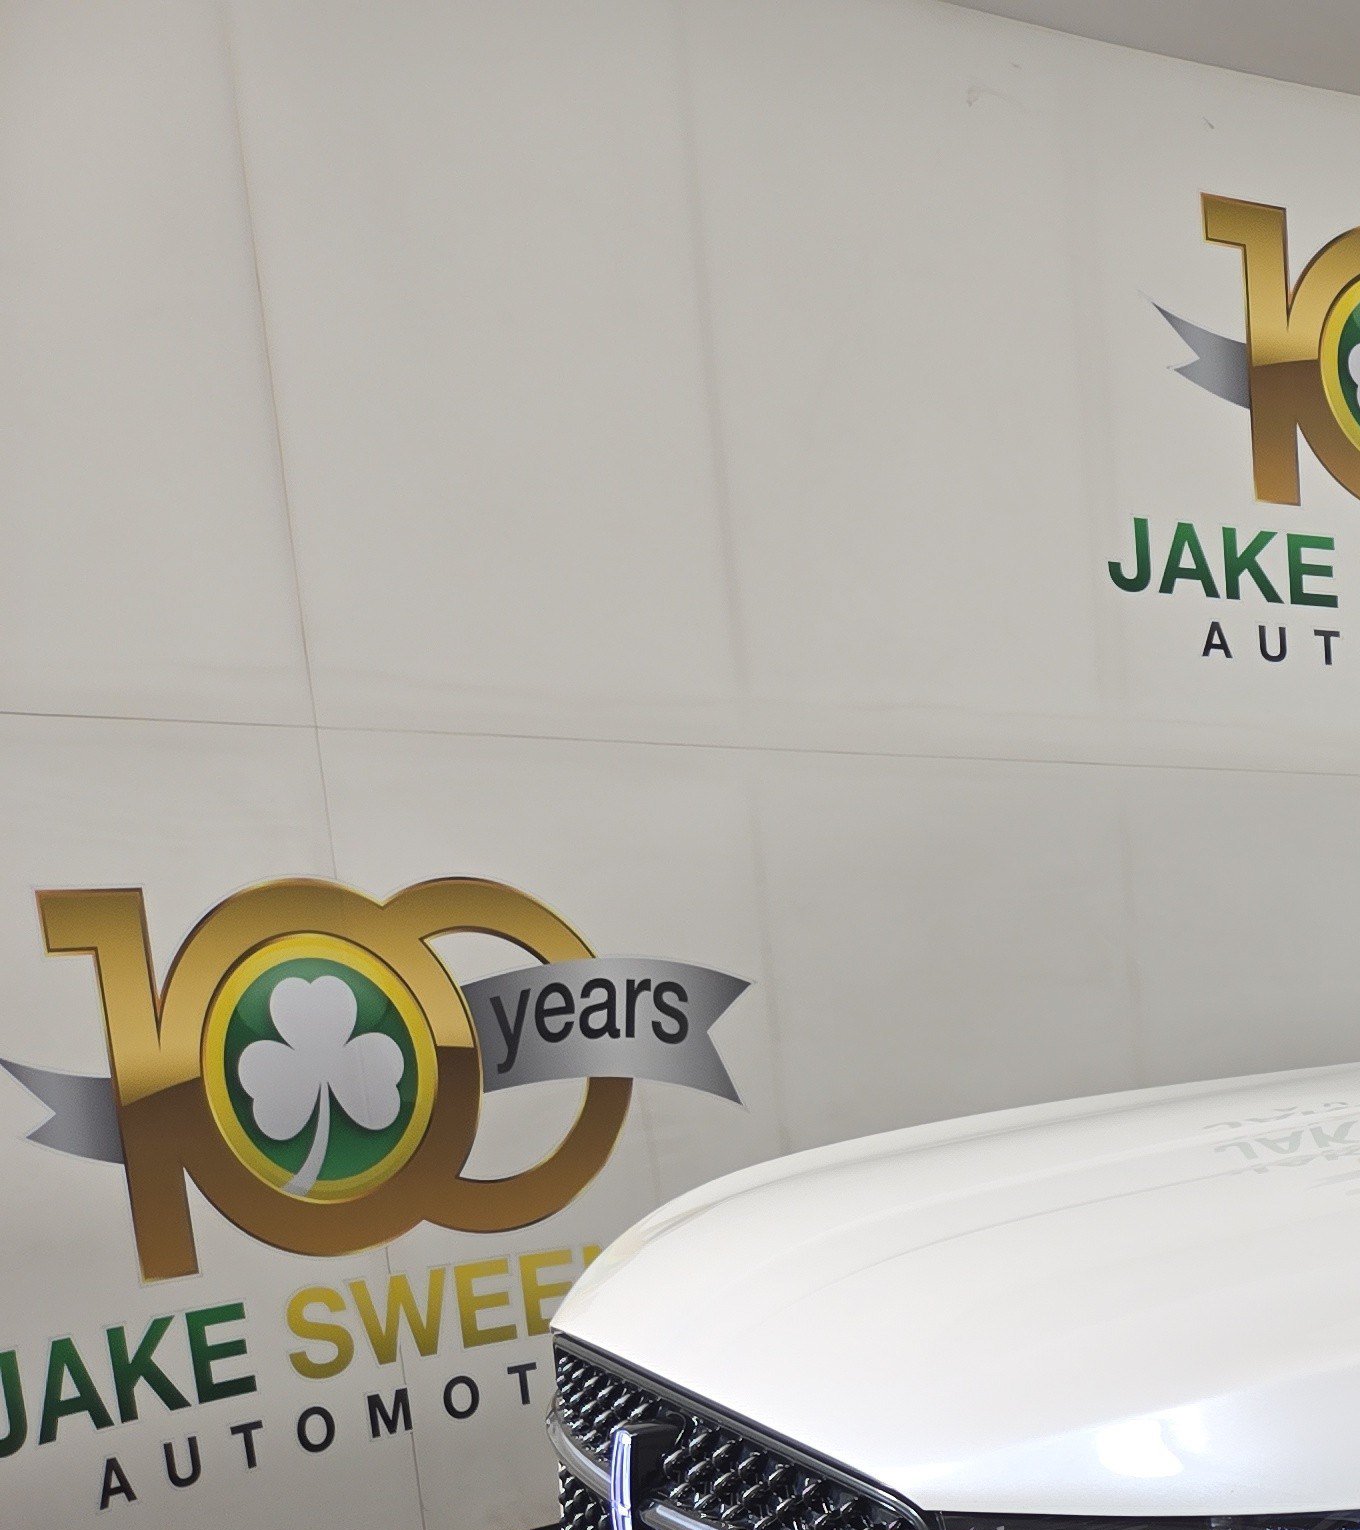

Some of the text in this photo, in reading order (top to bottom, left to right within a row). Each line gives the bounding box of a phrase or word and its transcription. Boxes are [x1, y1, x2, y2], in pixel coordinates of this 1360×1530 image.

[1107, 516, 1340, 609] JAKE
[36, 876, 691, 1283] 100 years
